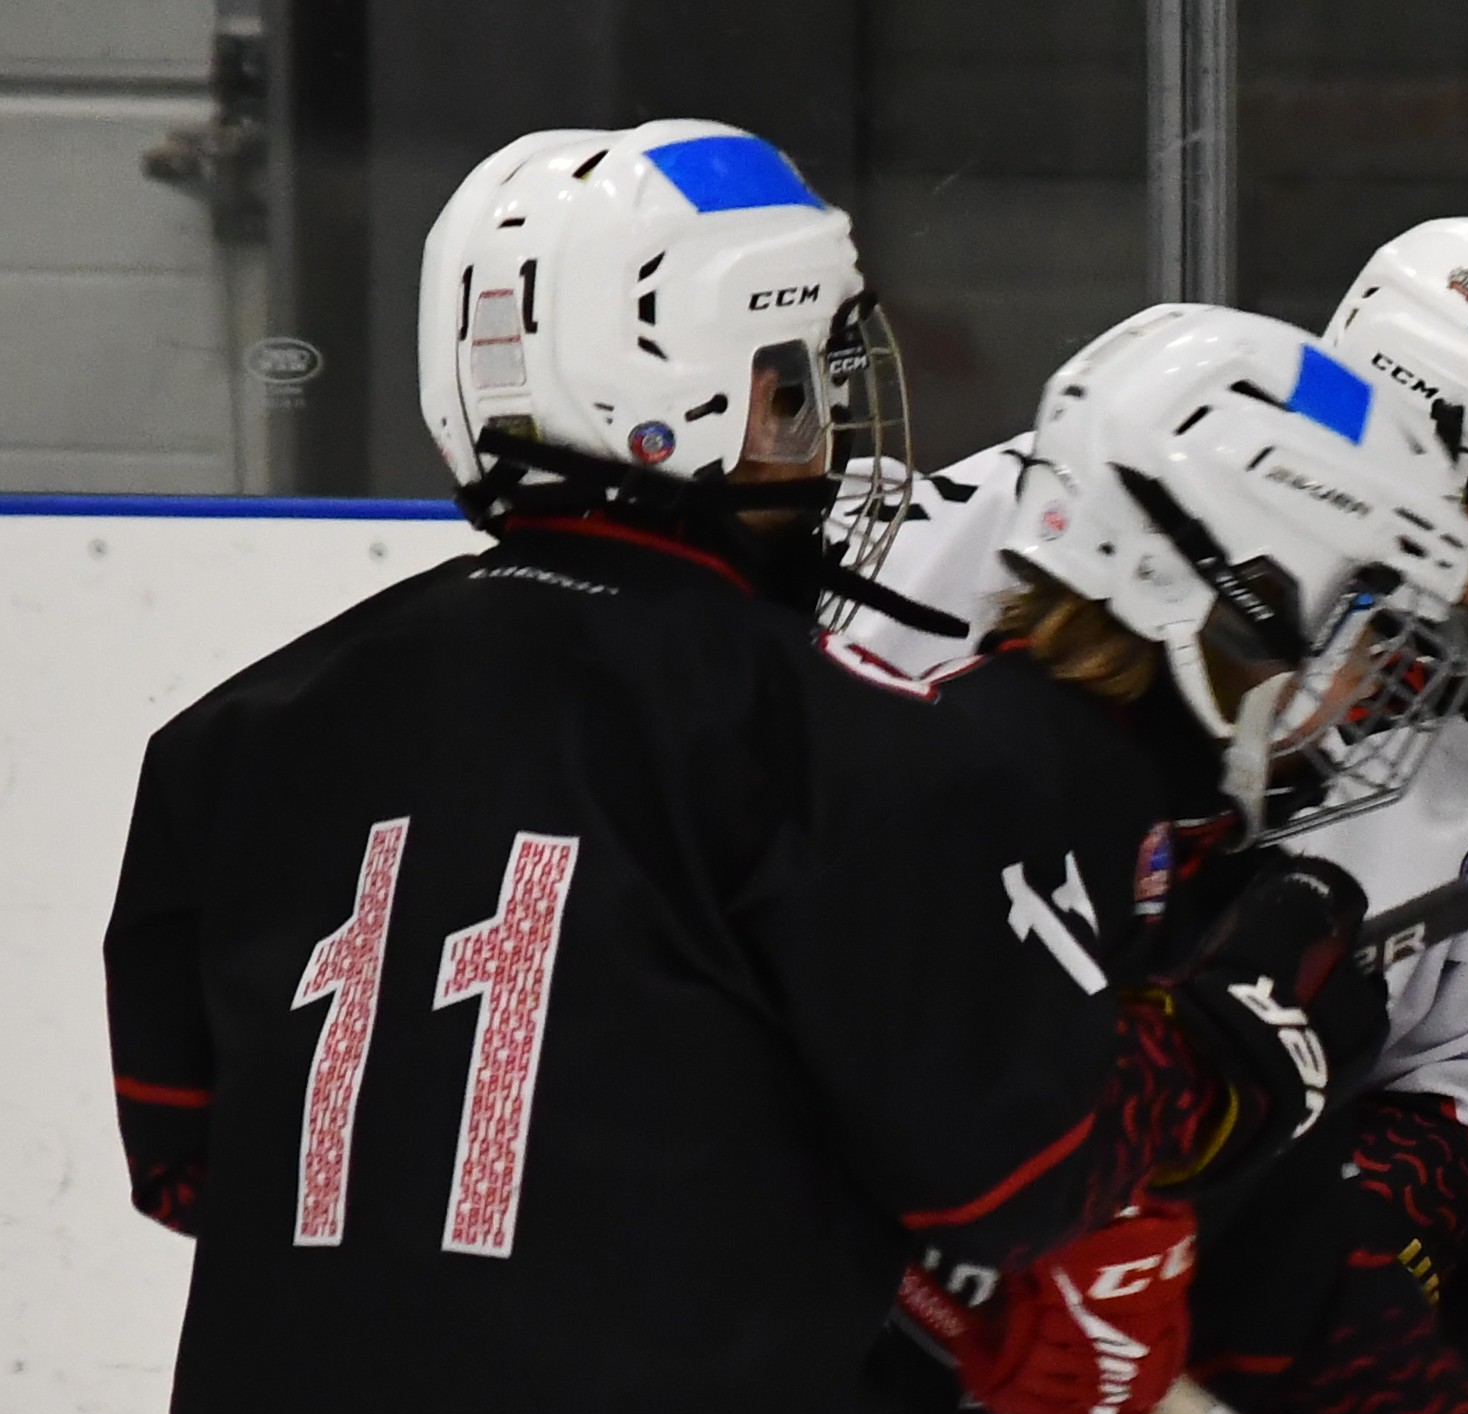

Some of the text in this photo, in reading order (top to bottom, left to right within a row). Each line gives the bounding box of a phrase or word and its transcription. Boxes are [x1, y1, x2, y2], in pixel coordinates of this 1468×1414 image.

[749, 284, 820, 311] CCM
[1371, 351, 1440, 399] CCM
[290, 815, 580, 1260] 11
